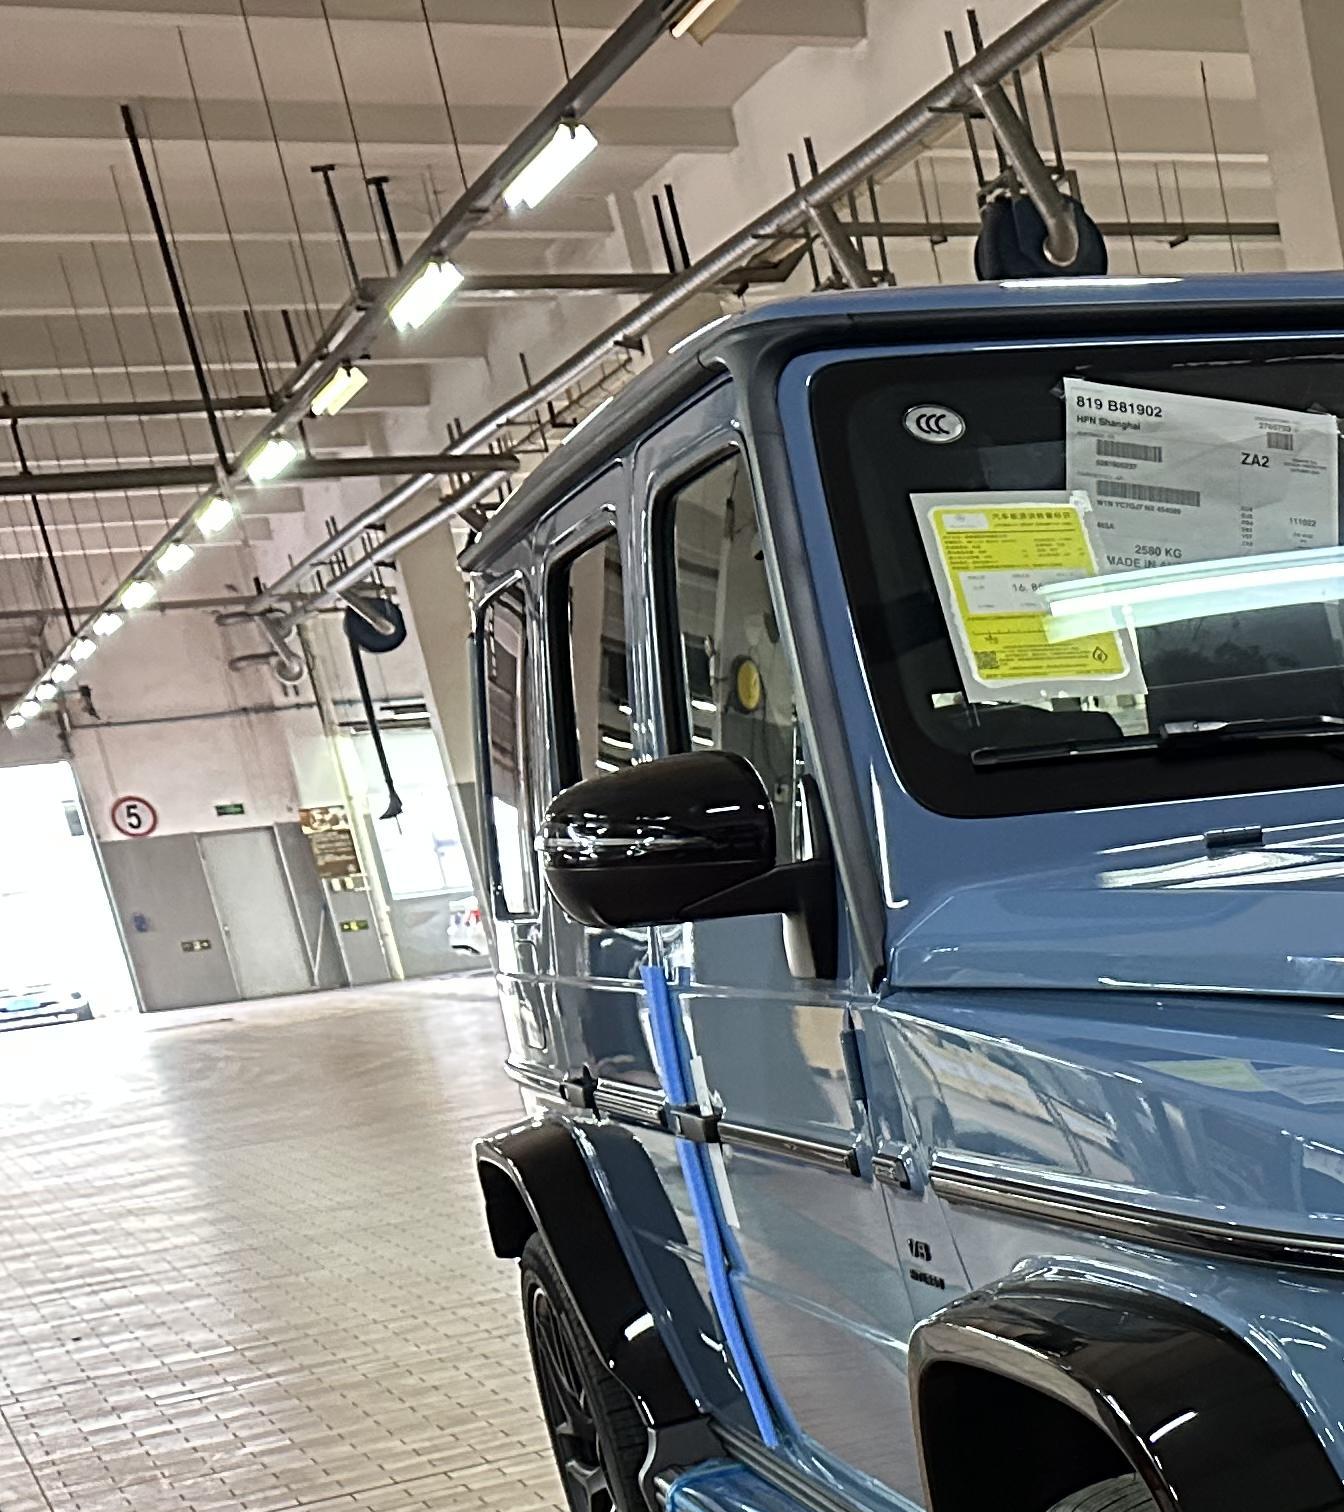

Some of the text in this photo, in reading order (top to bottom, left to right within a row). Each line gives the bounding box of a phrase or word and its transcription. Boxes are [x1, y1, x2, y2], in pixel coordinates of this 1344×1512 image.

[1076, 395, 1164, 418] 819 B81902
[1098, 417, 1141, 431] Shanghai
[1241, 451, 1270, 468] ZA2
[1134, 544, 1183, 559] 2580 KG
[1106, 555, 1141, 568] MADE
[126, 804, 142, 829] 5
